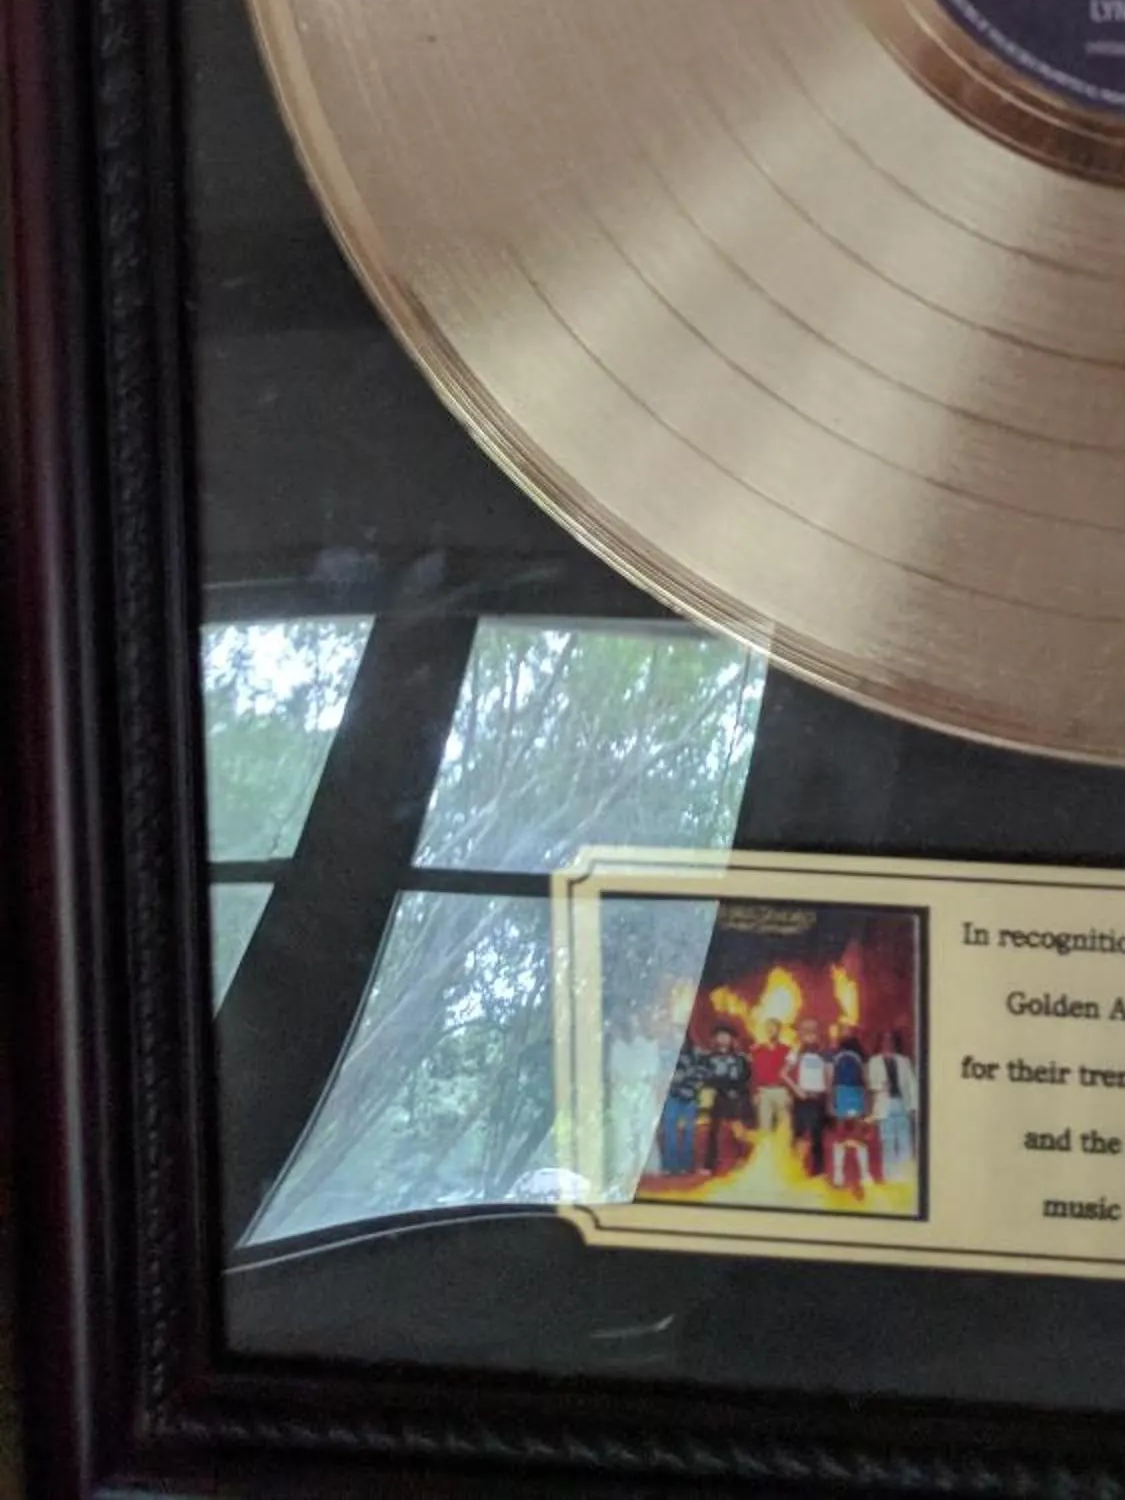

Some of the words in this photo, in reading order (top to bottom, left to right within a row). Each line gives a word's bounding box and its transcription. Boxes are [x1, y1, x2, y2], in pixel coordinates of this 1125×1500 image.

[962, 921, 990, 947] In
[1005, 991, 1101, 1020] Golden
[961, 1055, 1001, 1081] for
[1006, 1058, 1072, 1085] their
[1023, 1128, 1072, 1152] and
[1080, 1130, 1123, 1156] the
[1042, 1196, 1123, 1222] music
